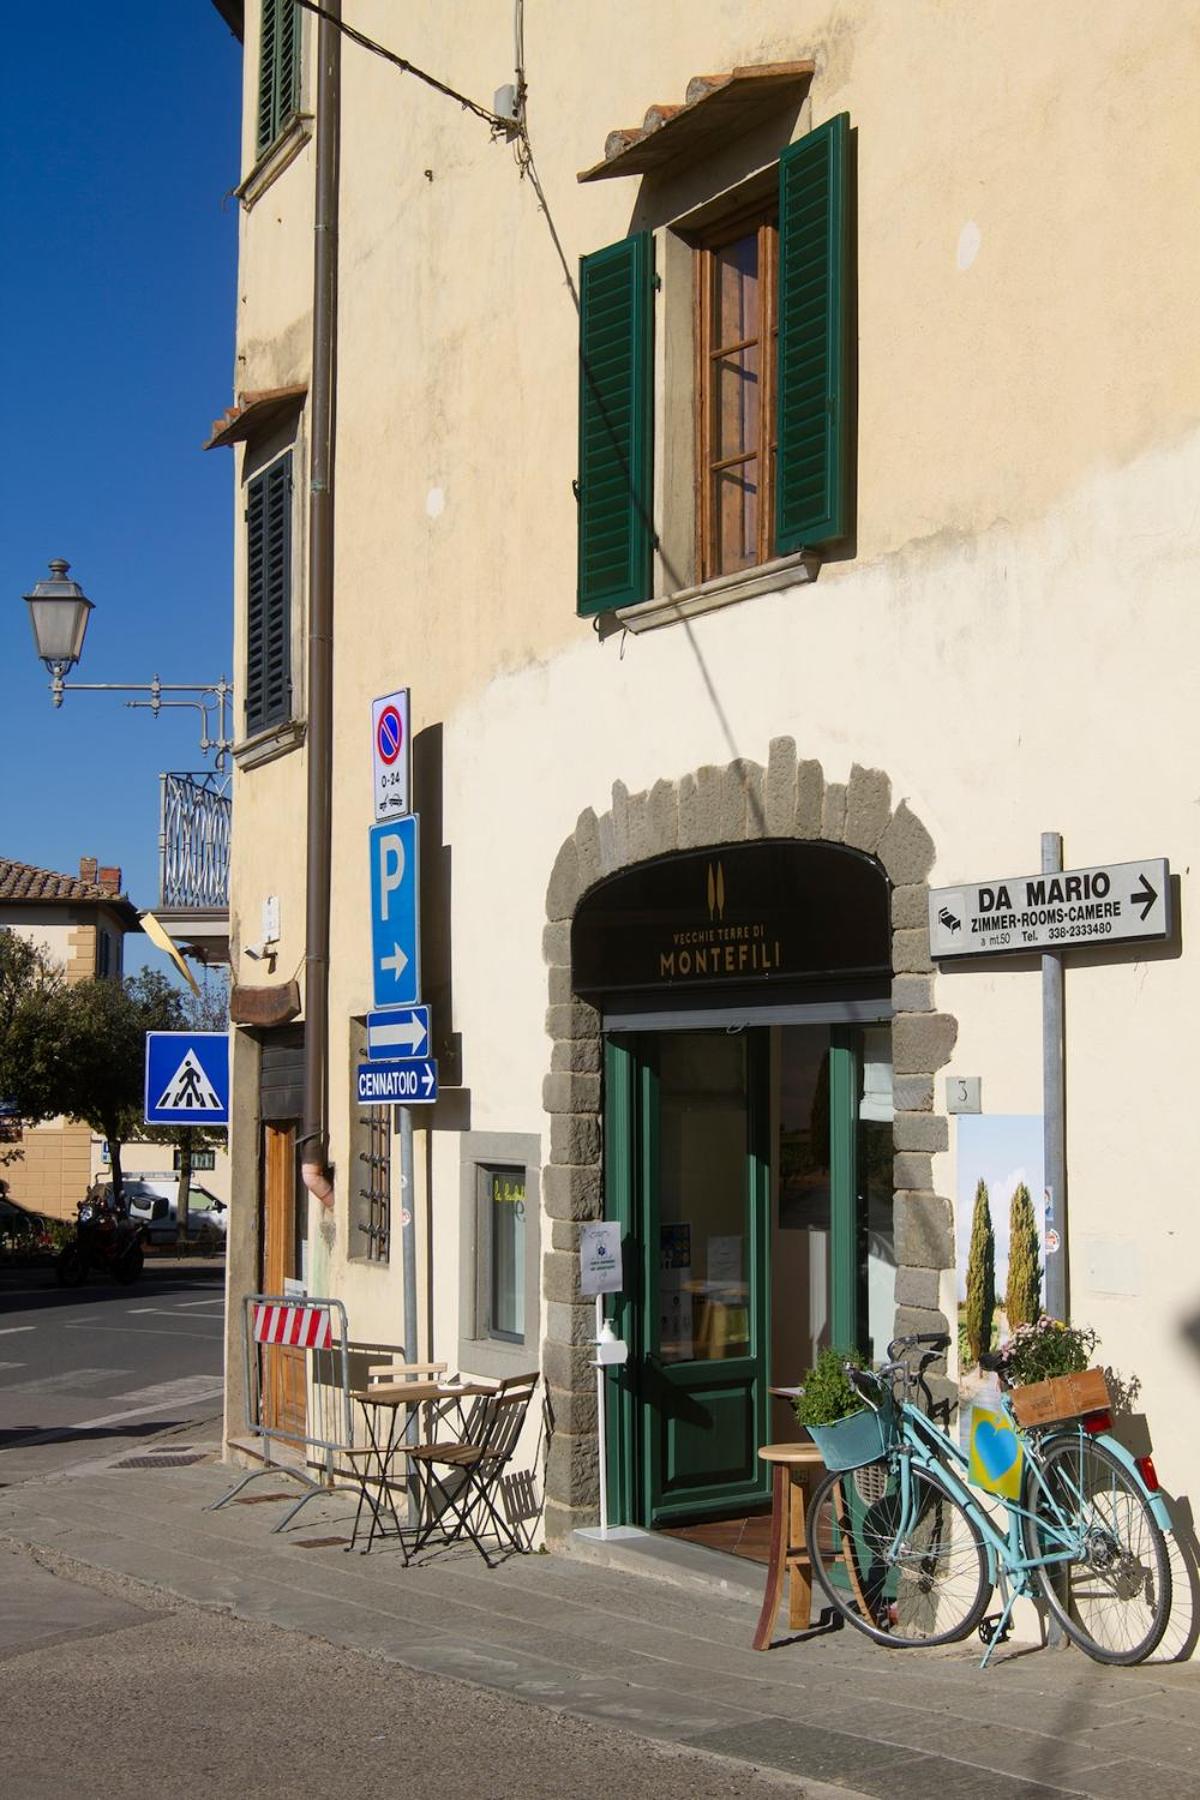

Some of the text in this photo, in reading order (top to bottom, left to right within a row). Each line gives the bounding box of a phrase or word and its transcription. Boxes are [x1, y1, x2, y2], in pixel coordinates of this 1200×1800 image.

[381, 771, 400, 788] 0-24
[380, 833, 405, 921] P
[978, 872, 1111, 913] DA MARIO
[672, 923, 764, 945] VECCHIE TERRE DI
[1021, 930, 1038, 942] Tel.
[660, 941, 779, 976] MONTEFILI
[359, 1070, 418, 1096] CENNATOIO
